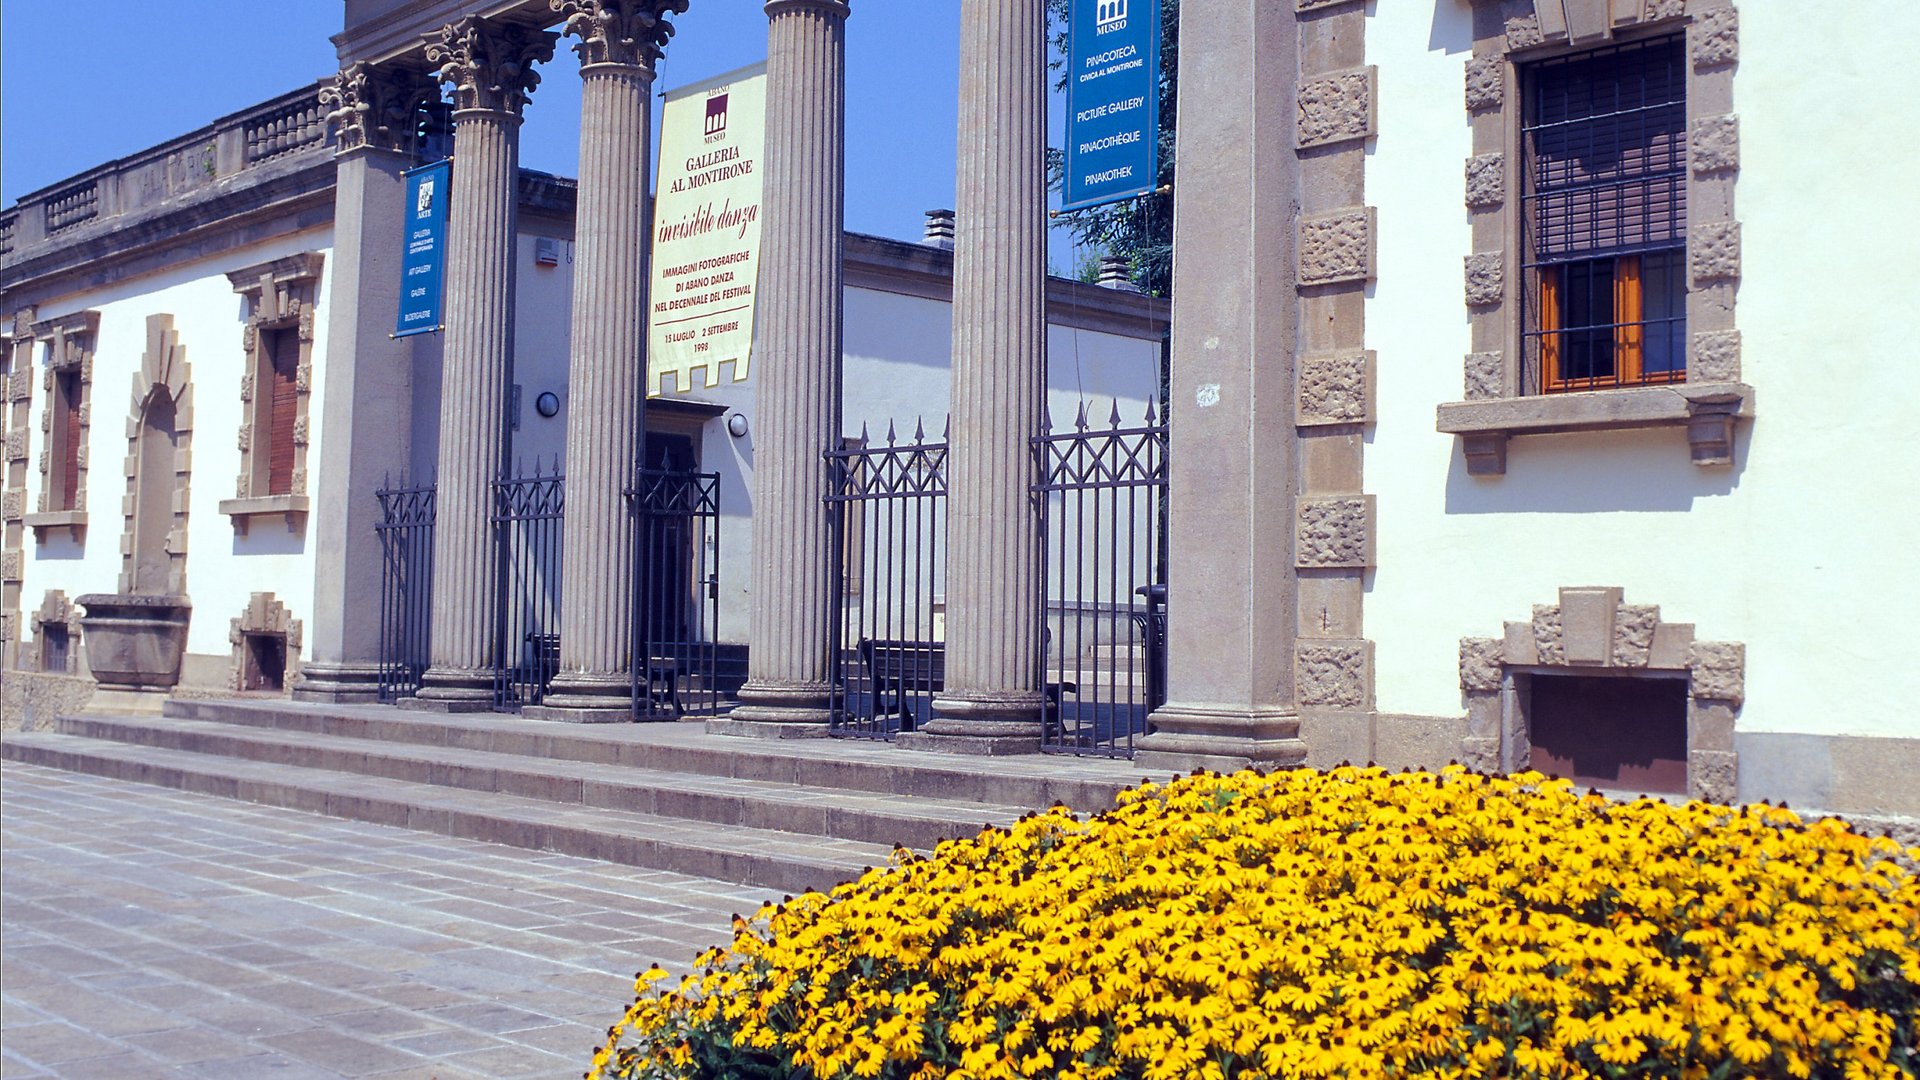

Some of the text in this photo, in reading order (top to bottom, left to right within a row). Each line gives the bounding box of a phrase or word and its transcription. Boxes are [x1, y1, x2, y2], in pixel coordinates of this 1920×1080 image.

[1096, 19, 1127, 36] MUSEO
[1086, 44, 1136, 68] PINACOTECA
[1080, 59, 1143, 82] CIVICA AL MONTIRONE
[1077, 96, 1144, 123] PICTURE GALLERY
[704, 132, 726, 145] MUSEO
[1080, 130, 1140, 154] PINACOTHÈQUE
[686, 146, 740, 171] GALLERIA
[670, 160, 753, 193] AL MONTIRONE
[1085, 166, 1132, 186] PINAKOTHEK
[417, 209, 432, 220] ARTE
[658, 197, 759, 243] invisibile danza
[415, 264, 431, 275] GALLERY
[662, 251, 750, 279] IMMAGINI FOTOGRAFICHE
[676, 271, 734, 293] DI ABANO DANZA
[655, 285, 751, 312] NEL DECENNALE DEL FESTIVAL
[665, 321, 739, 343] 15 LUGLIO 2 SETTEMBRE
[694, 342, 709, 353] 1998
